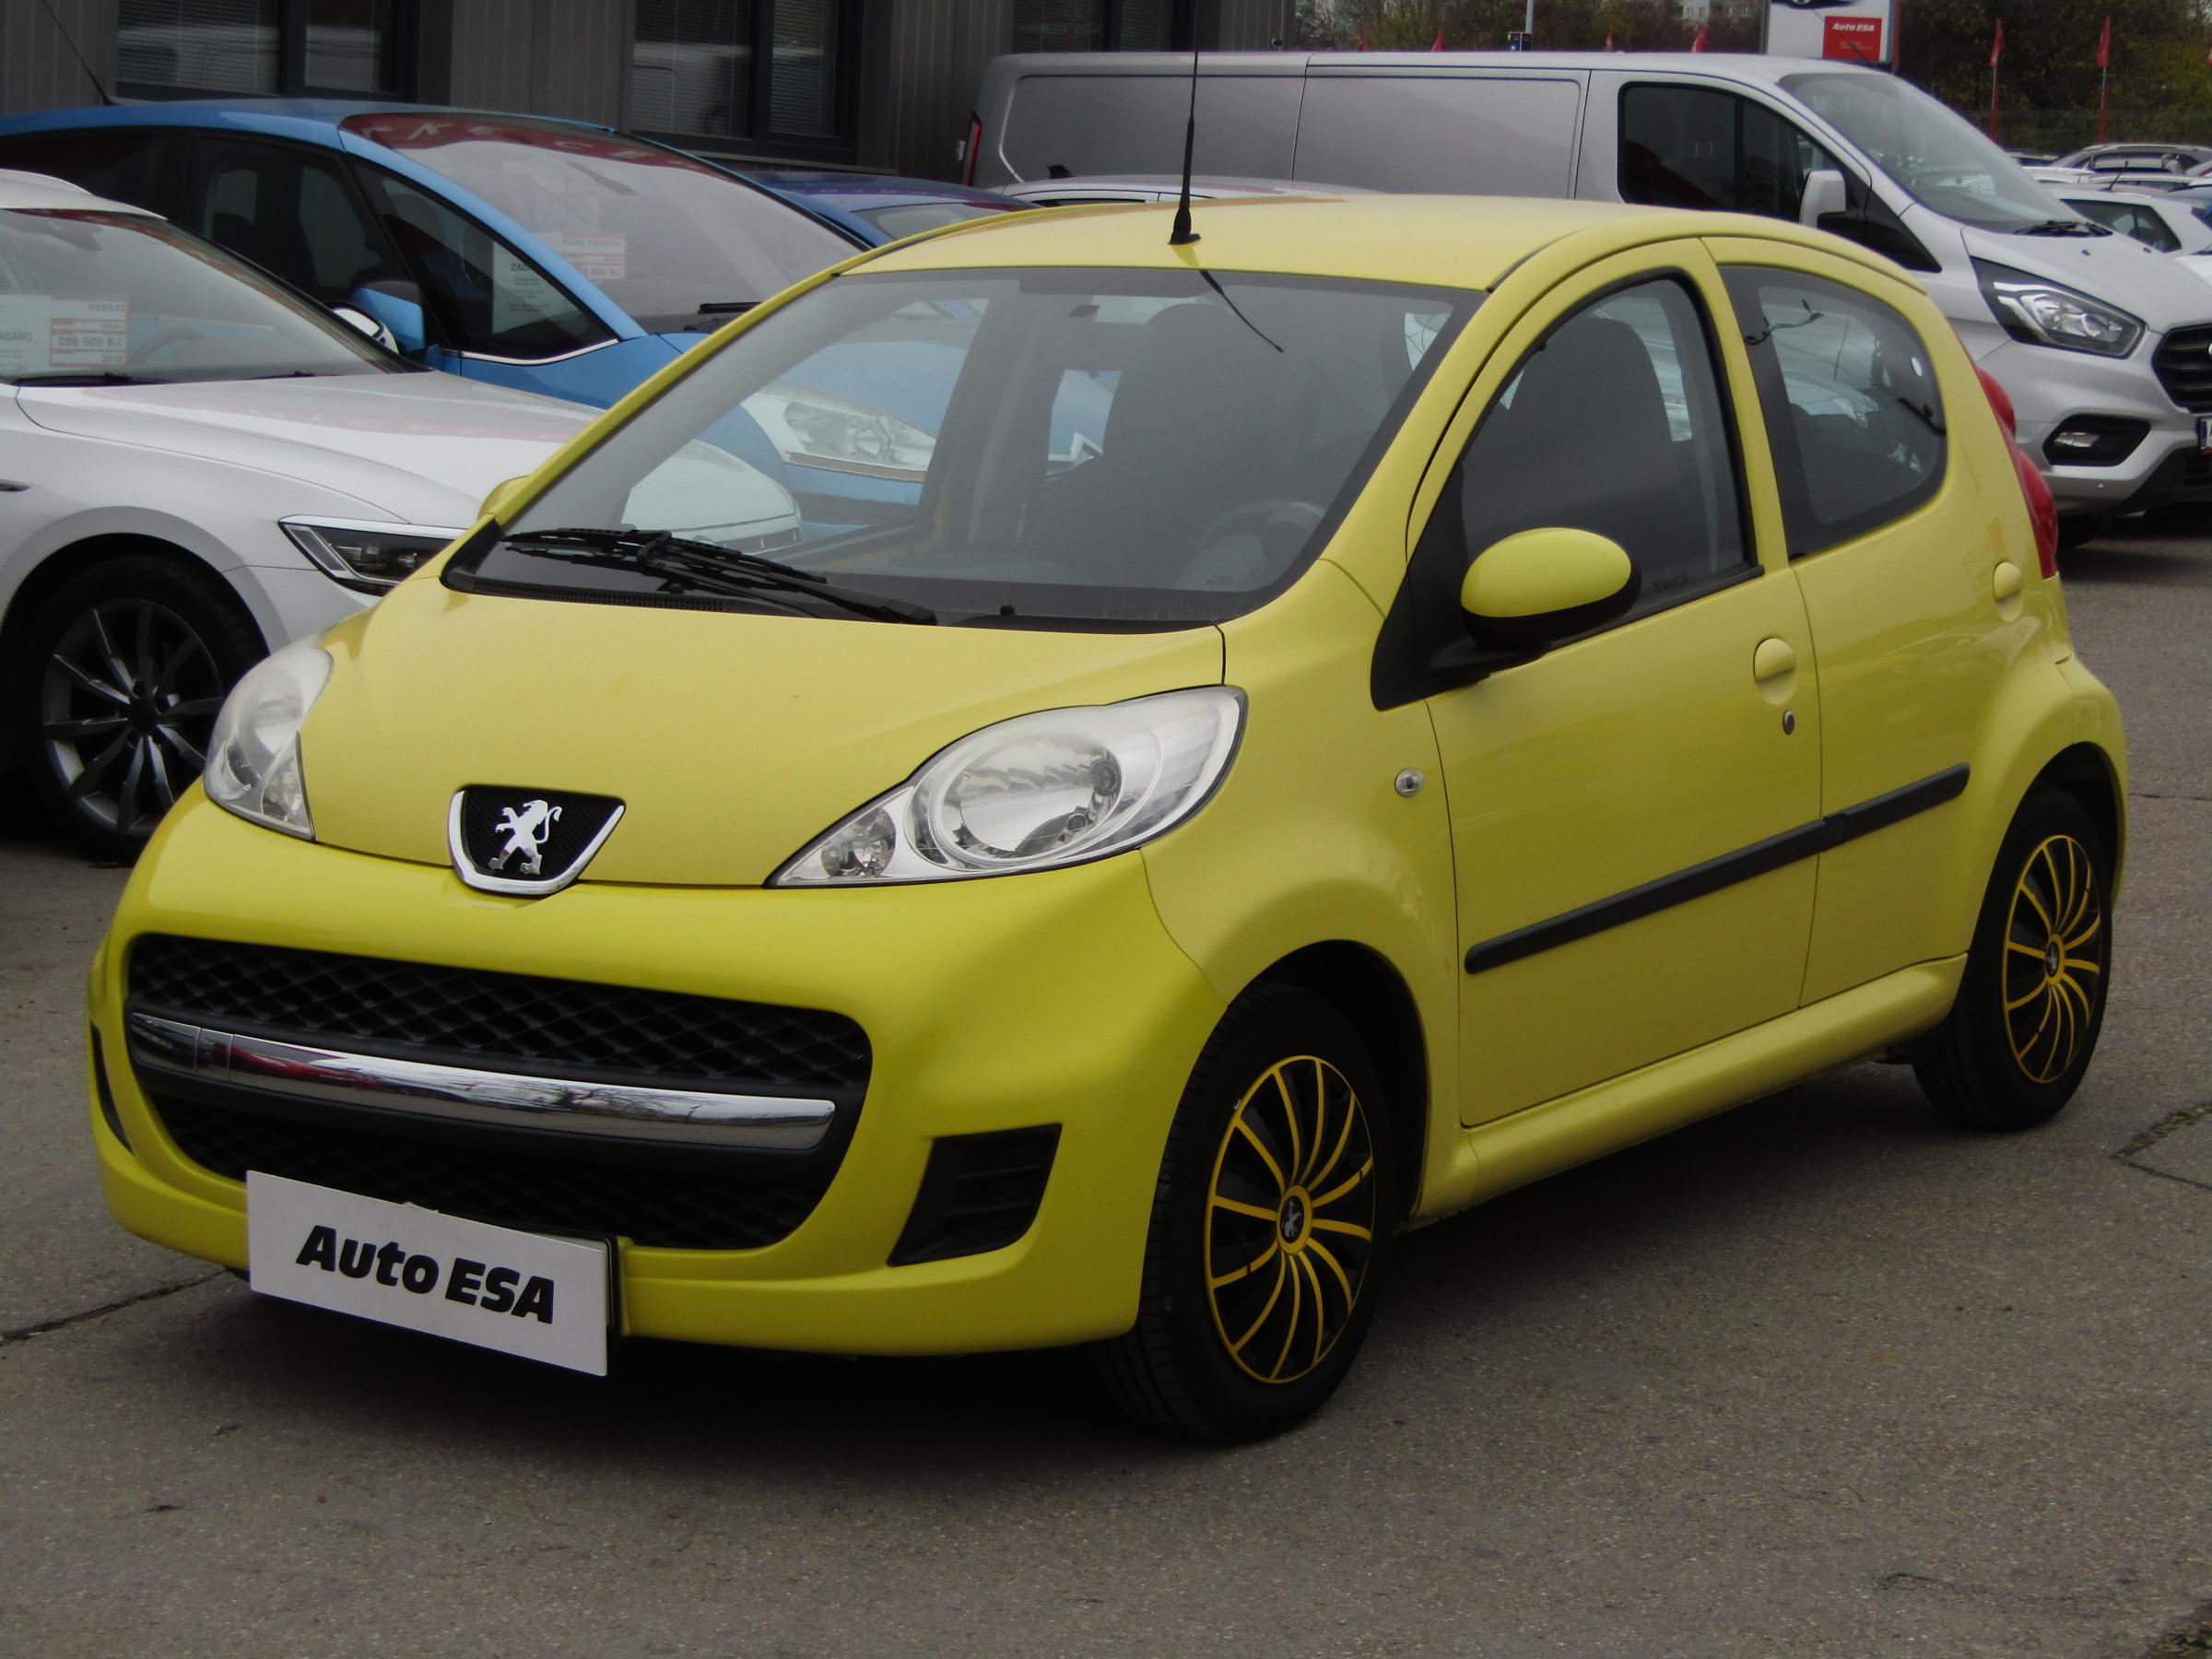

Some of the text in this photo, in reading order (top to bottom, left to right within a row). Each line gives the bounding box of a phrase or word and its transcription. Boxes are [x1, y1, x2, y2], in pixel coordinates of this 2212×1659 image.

[1832, 22, 1875, 33] Auto ESA
[83, 335, 104, 347] 000
[296, 1224, 555, 1325] Auto ESA
